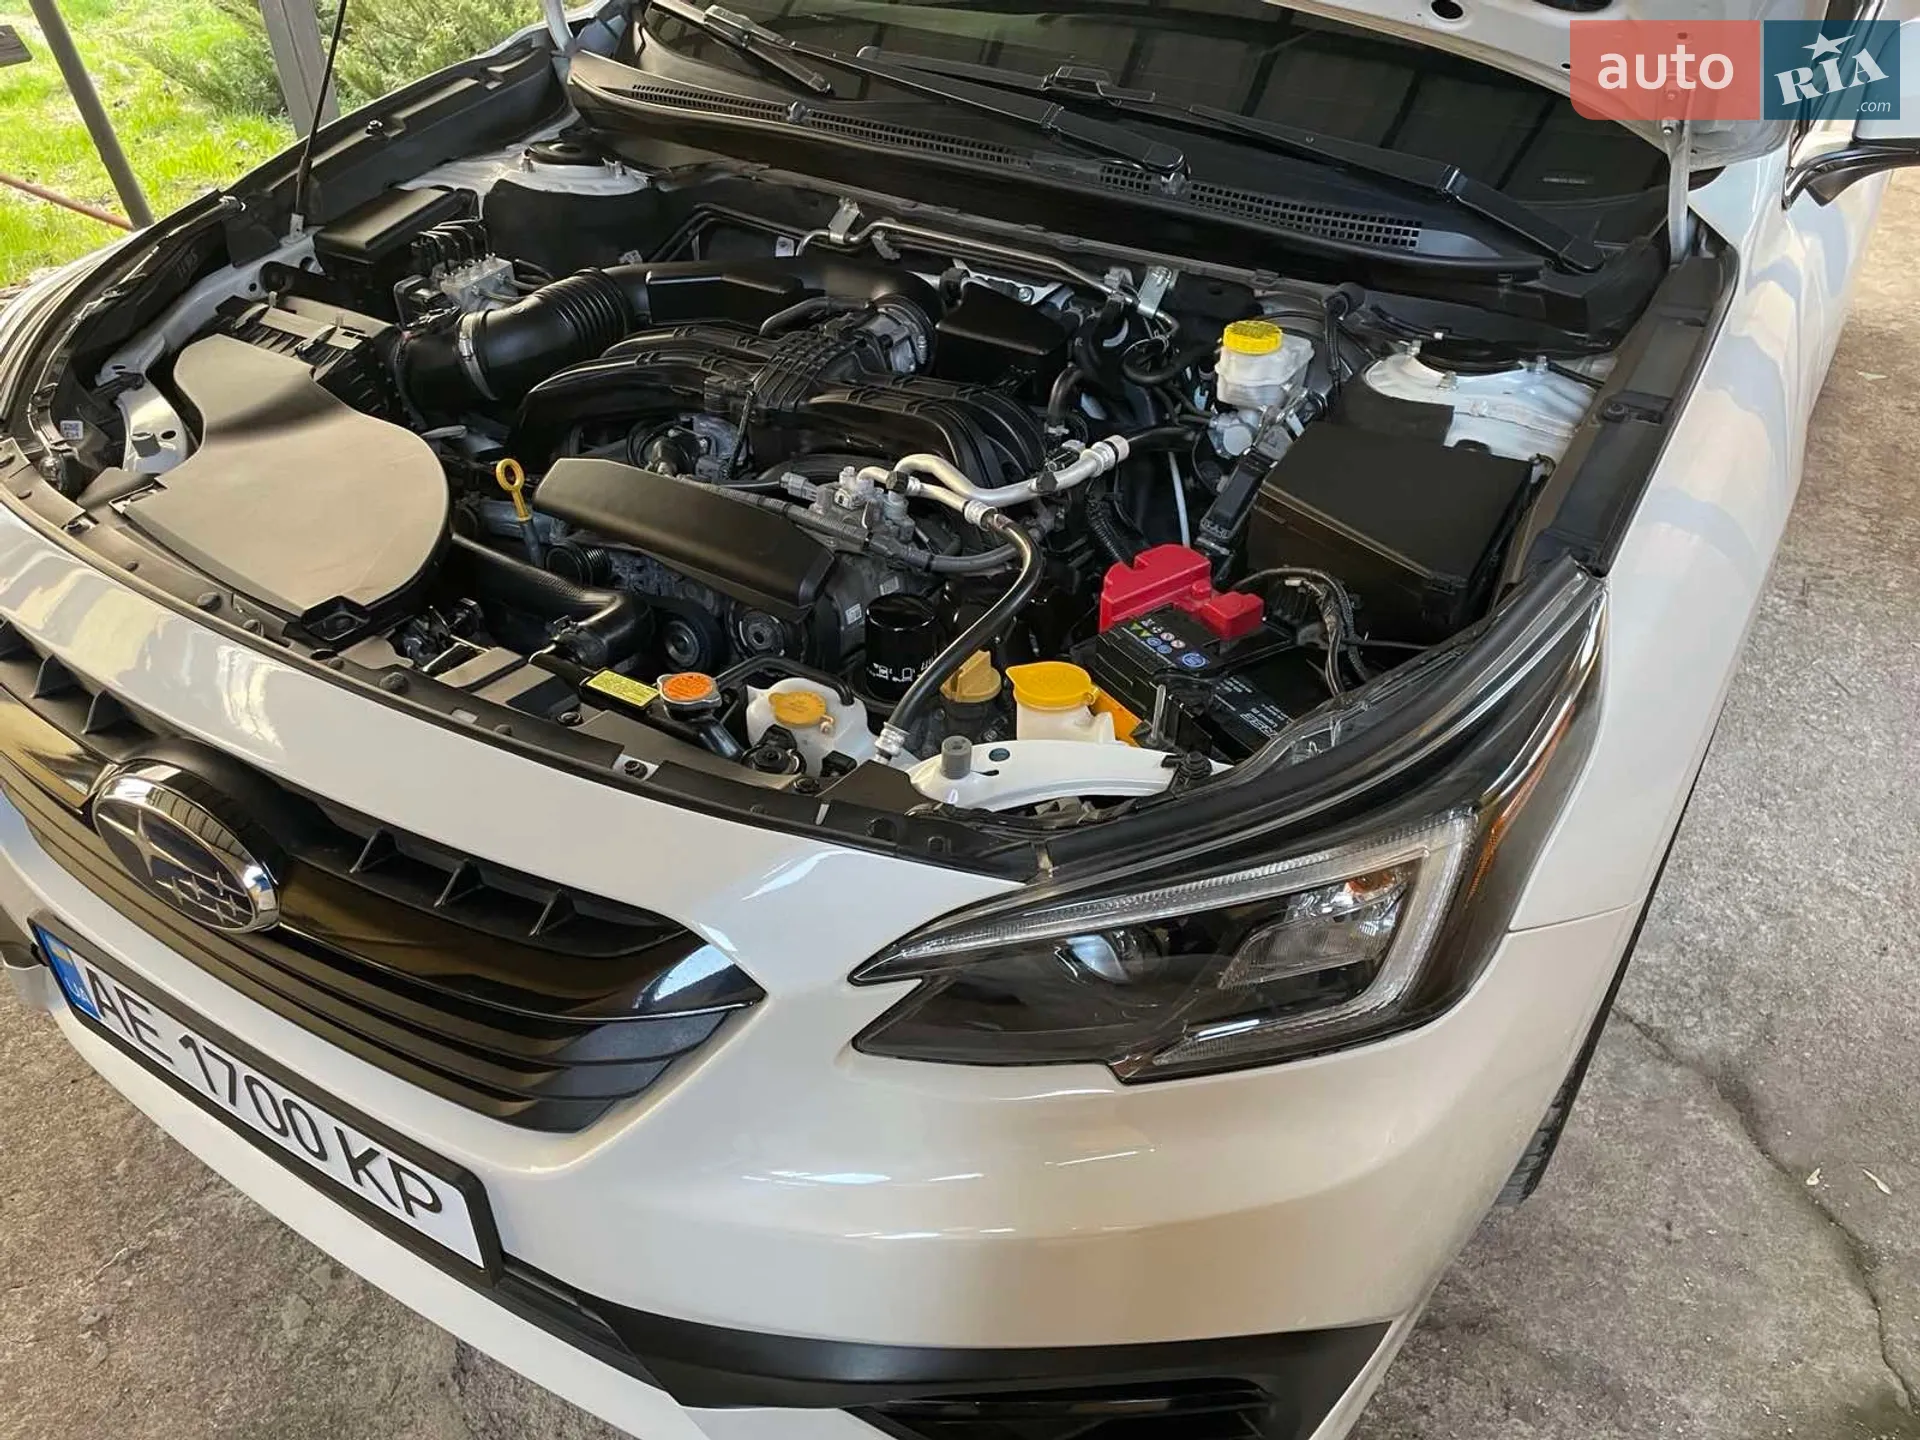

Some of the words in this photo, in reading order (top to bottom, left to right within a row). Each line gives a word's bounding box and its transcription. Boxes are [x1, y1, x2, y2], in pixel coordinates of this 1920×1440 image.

[86, 966, 174, 1065] AE
[179, 1034, 328, 1162] 1700
[334, 1126, 443, 1218] KP
